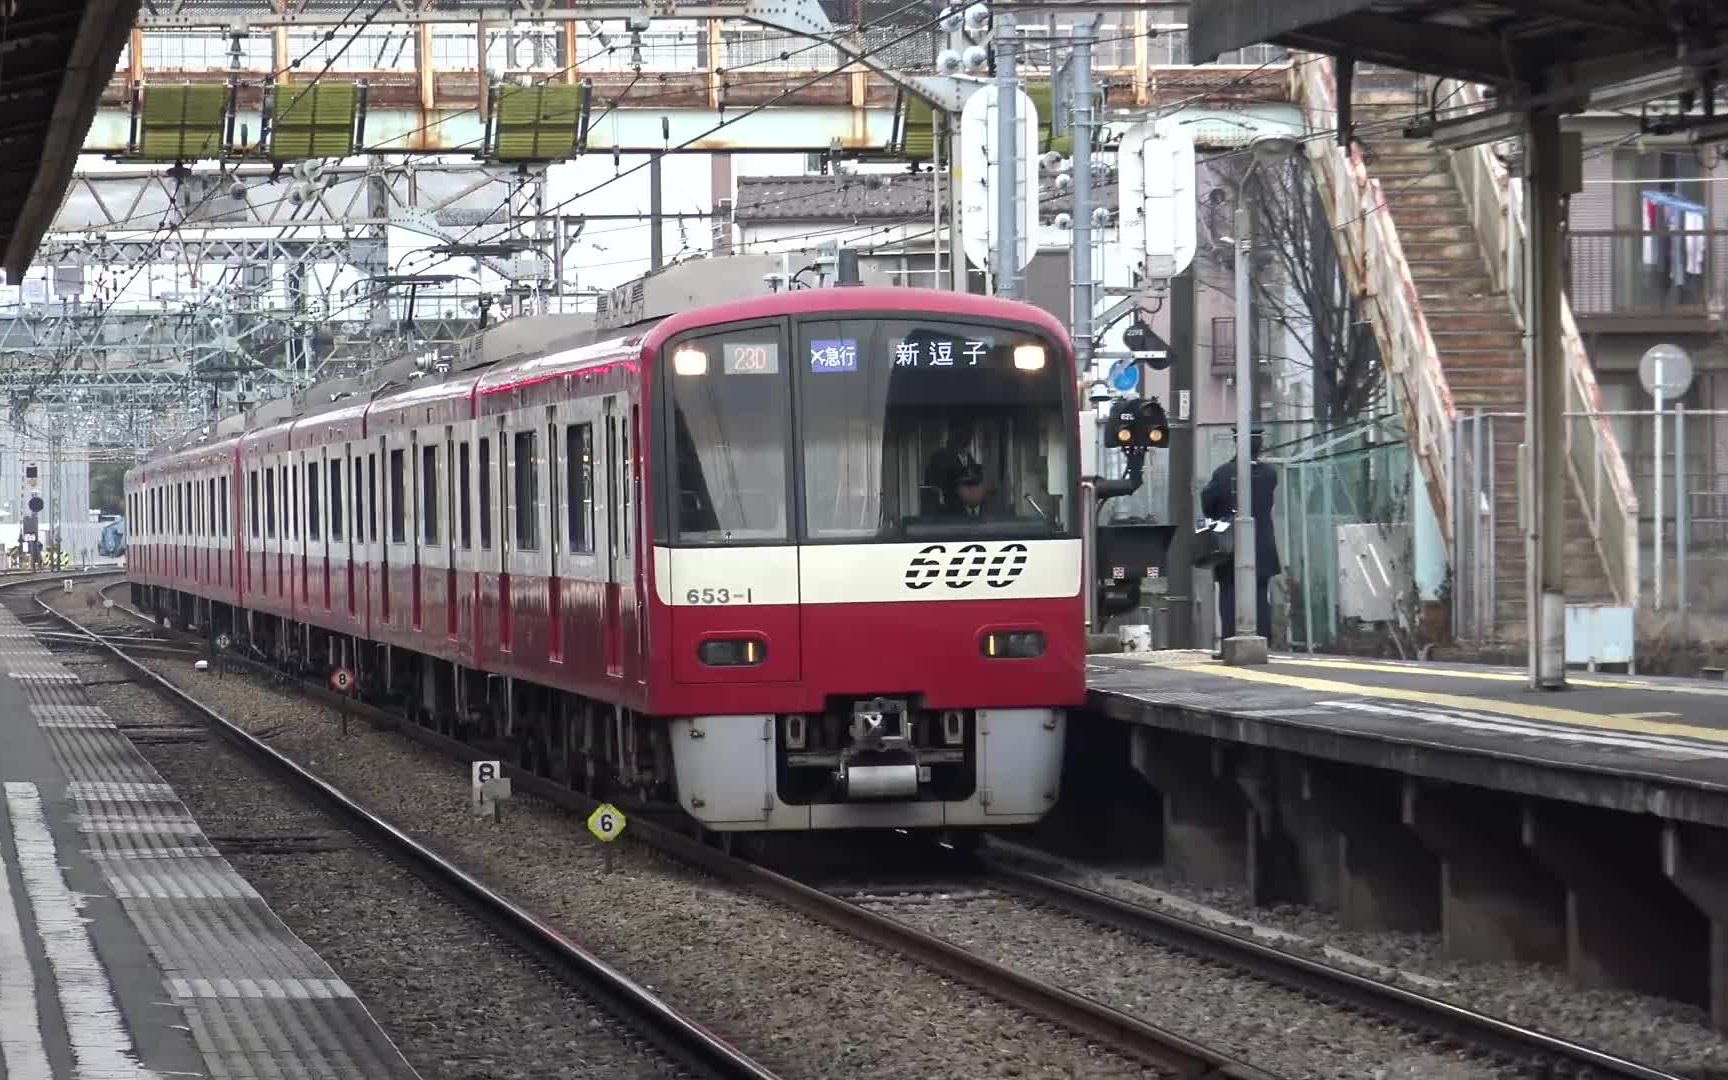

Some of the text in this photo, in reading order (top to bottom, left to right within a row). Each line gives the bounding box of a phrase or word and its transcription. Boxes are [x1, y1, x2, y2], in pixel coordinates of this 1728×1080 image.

[896, 341, 987, 366] 新逗子
[905, 543, 1028, 590] 600
[686, 588, 752, 604] 653-1
[339, 673, 347, 685] 8
[601, 814, 613, 832] 6
